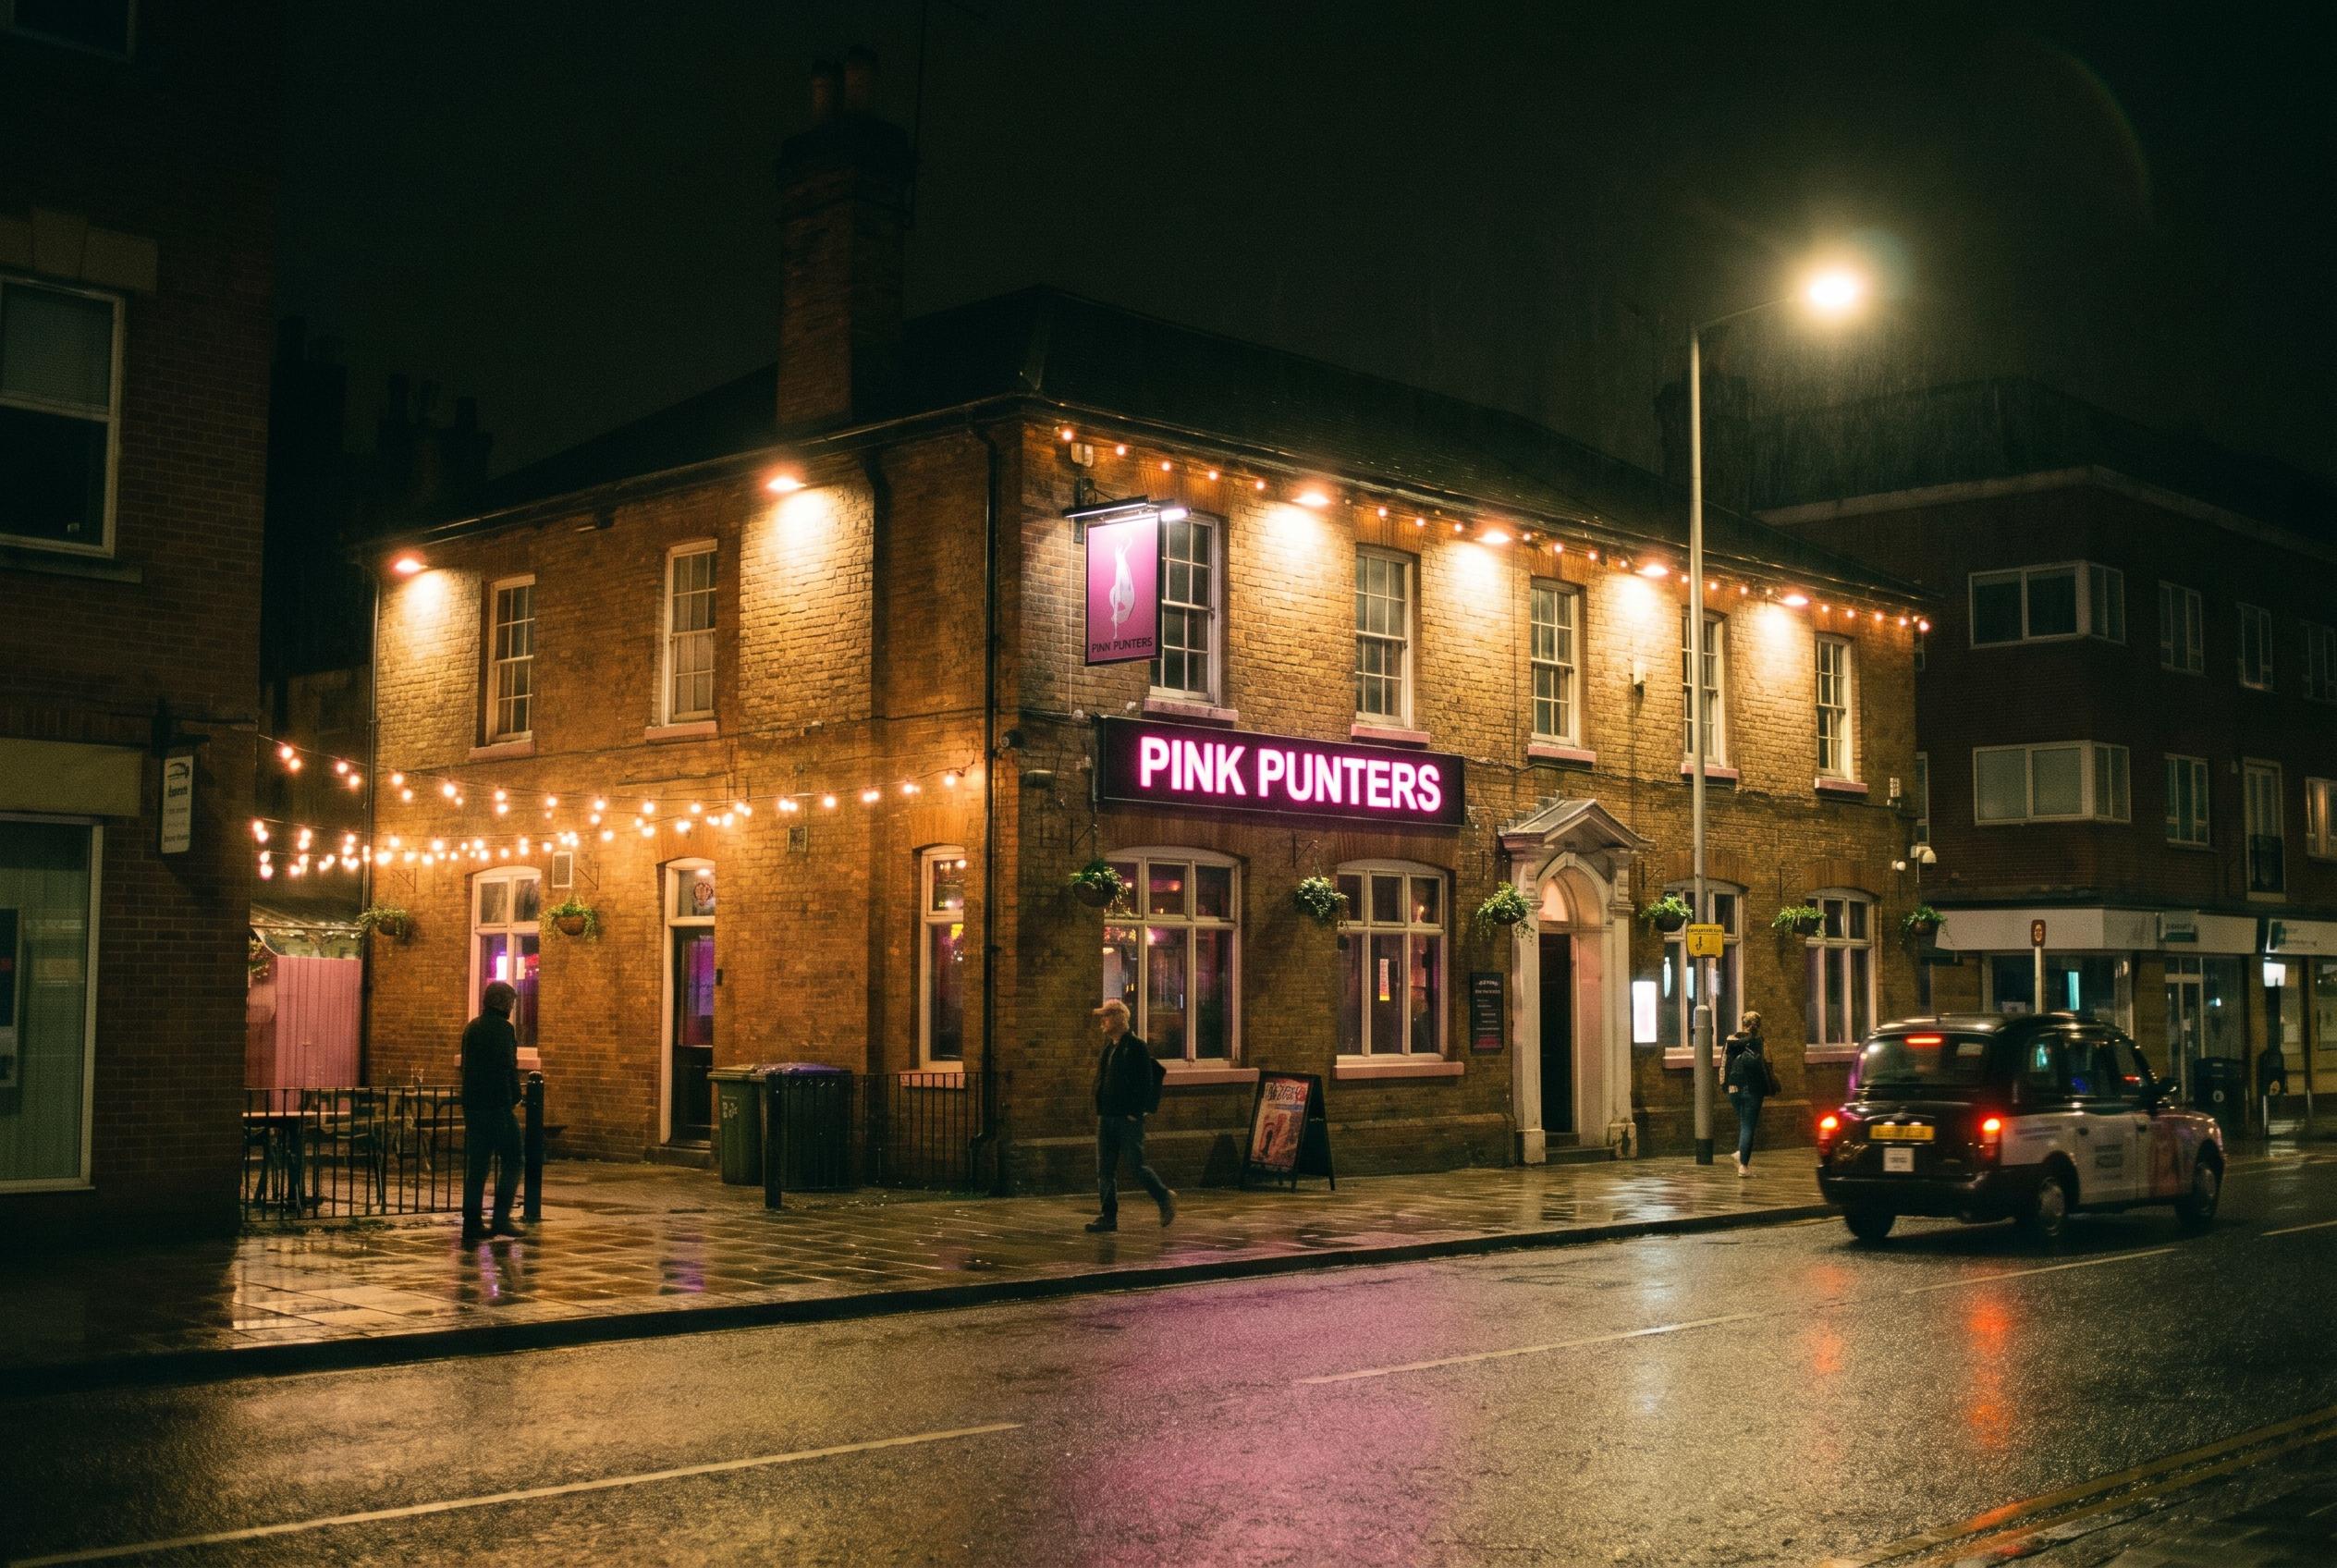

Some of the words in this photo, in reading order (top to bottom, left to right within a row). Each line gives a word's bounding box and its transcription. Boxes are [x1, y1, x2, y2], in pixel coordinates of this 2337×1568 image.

[1113, 637, 1153, 651] PUNTERS
[1140, 736, 1246, 796] PINK
[1258, 747, 1441, 813] PUNTERS
